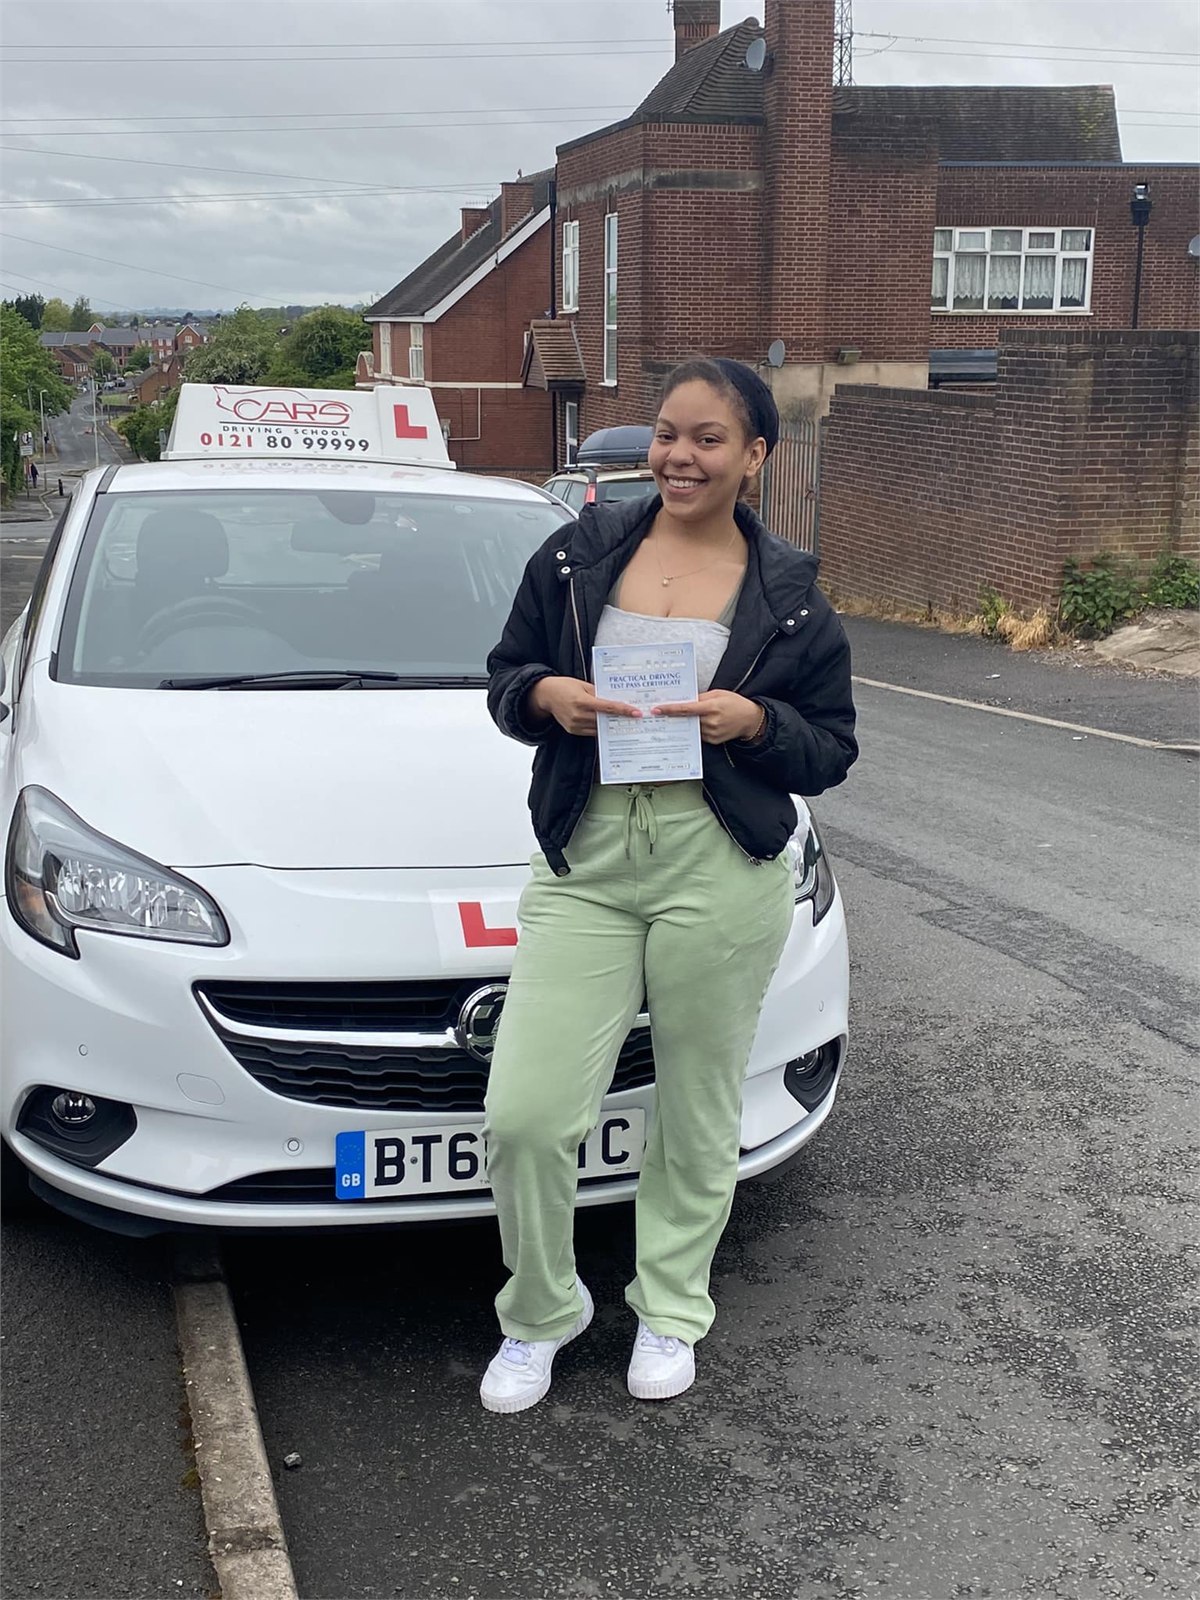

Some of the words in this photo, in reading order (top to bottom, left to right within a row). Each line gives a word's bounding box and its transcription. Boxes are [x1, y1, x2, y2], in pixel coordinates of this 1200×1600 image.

[233, 398, 353, 425] CARS
[393, 404, 428, 438] L
[222, 425, 283, 434] DRIVING
[294, 428, 349, 437] SCHOOL
[200, 432, 253, 448] 0121
[266, 435, 292, 449] 80
[303, 437, 370, 452] 99999
[609, 674, 647, 682] PRACTICAL
[649, 672, 681, 680] DRIVING
[642, 679, 681, 687] CERTIFICATE
[457, 902, 518, 948] L
[373, 1132, 488, 1187] BT6
[341, 1173, 361, 1187] GB
